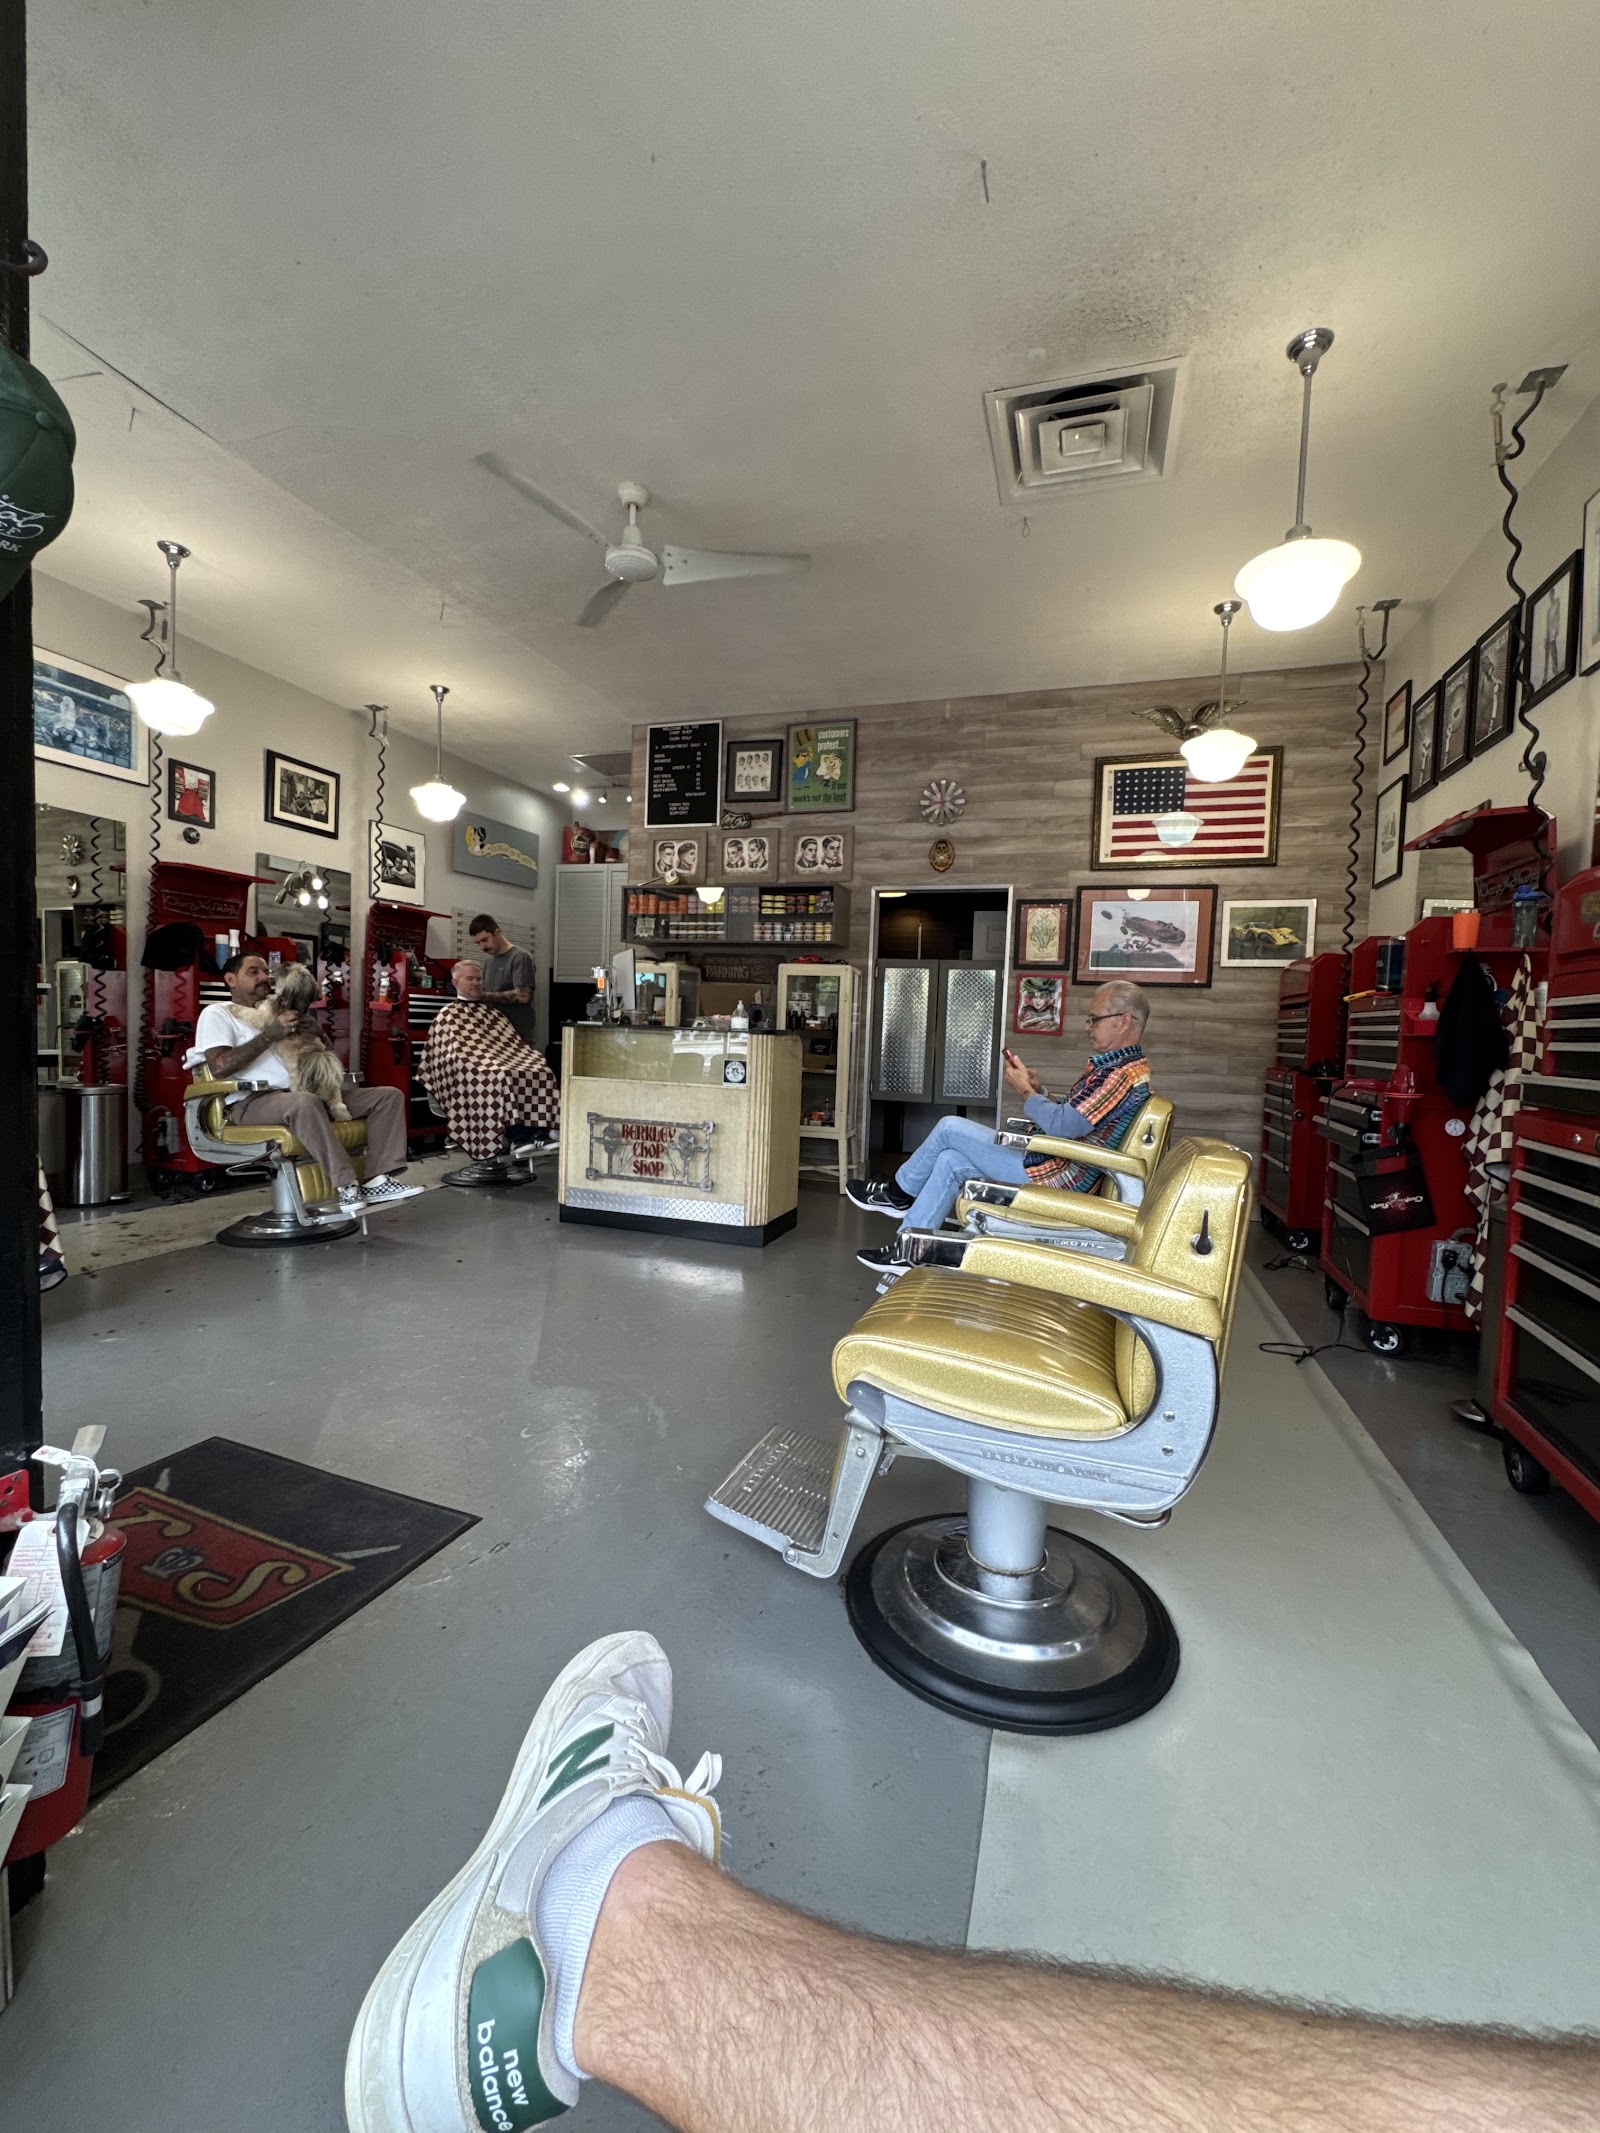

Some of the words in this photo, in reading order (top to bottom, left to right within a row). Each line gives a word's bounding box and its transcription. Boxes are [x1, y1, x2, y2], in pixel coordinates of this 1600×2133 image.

[818, 729, 849, 740] customers
[812, 794, 822, 802] not
[823, 793, 832, 802] the
[833, 792, 847, 802] best
[622, 1123, 677, 1144] BERKLEY
[477, 2019, 514, 2132] balance
[503, 2048, 529, 2105] new
